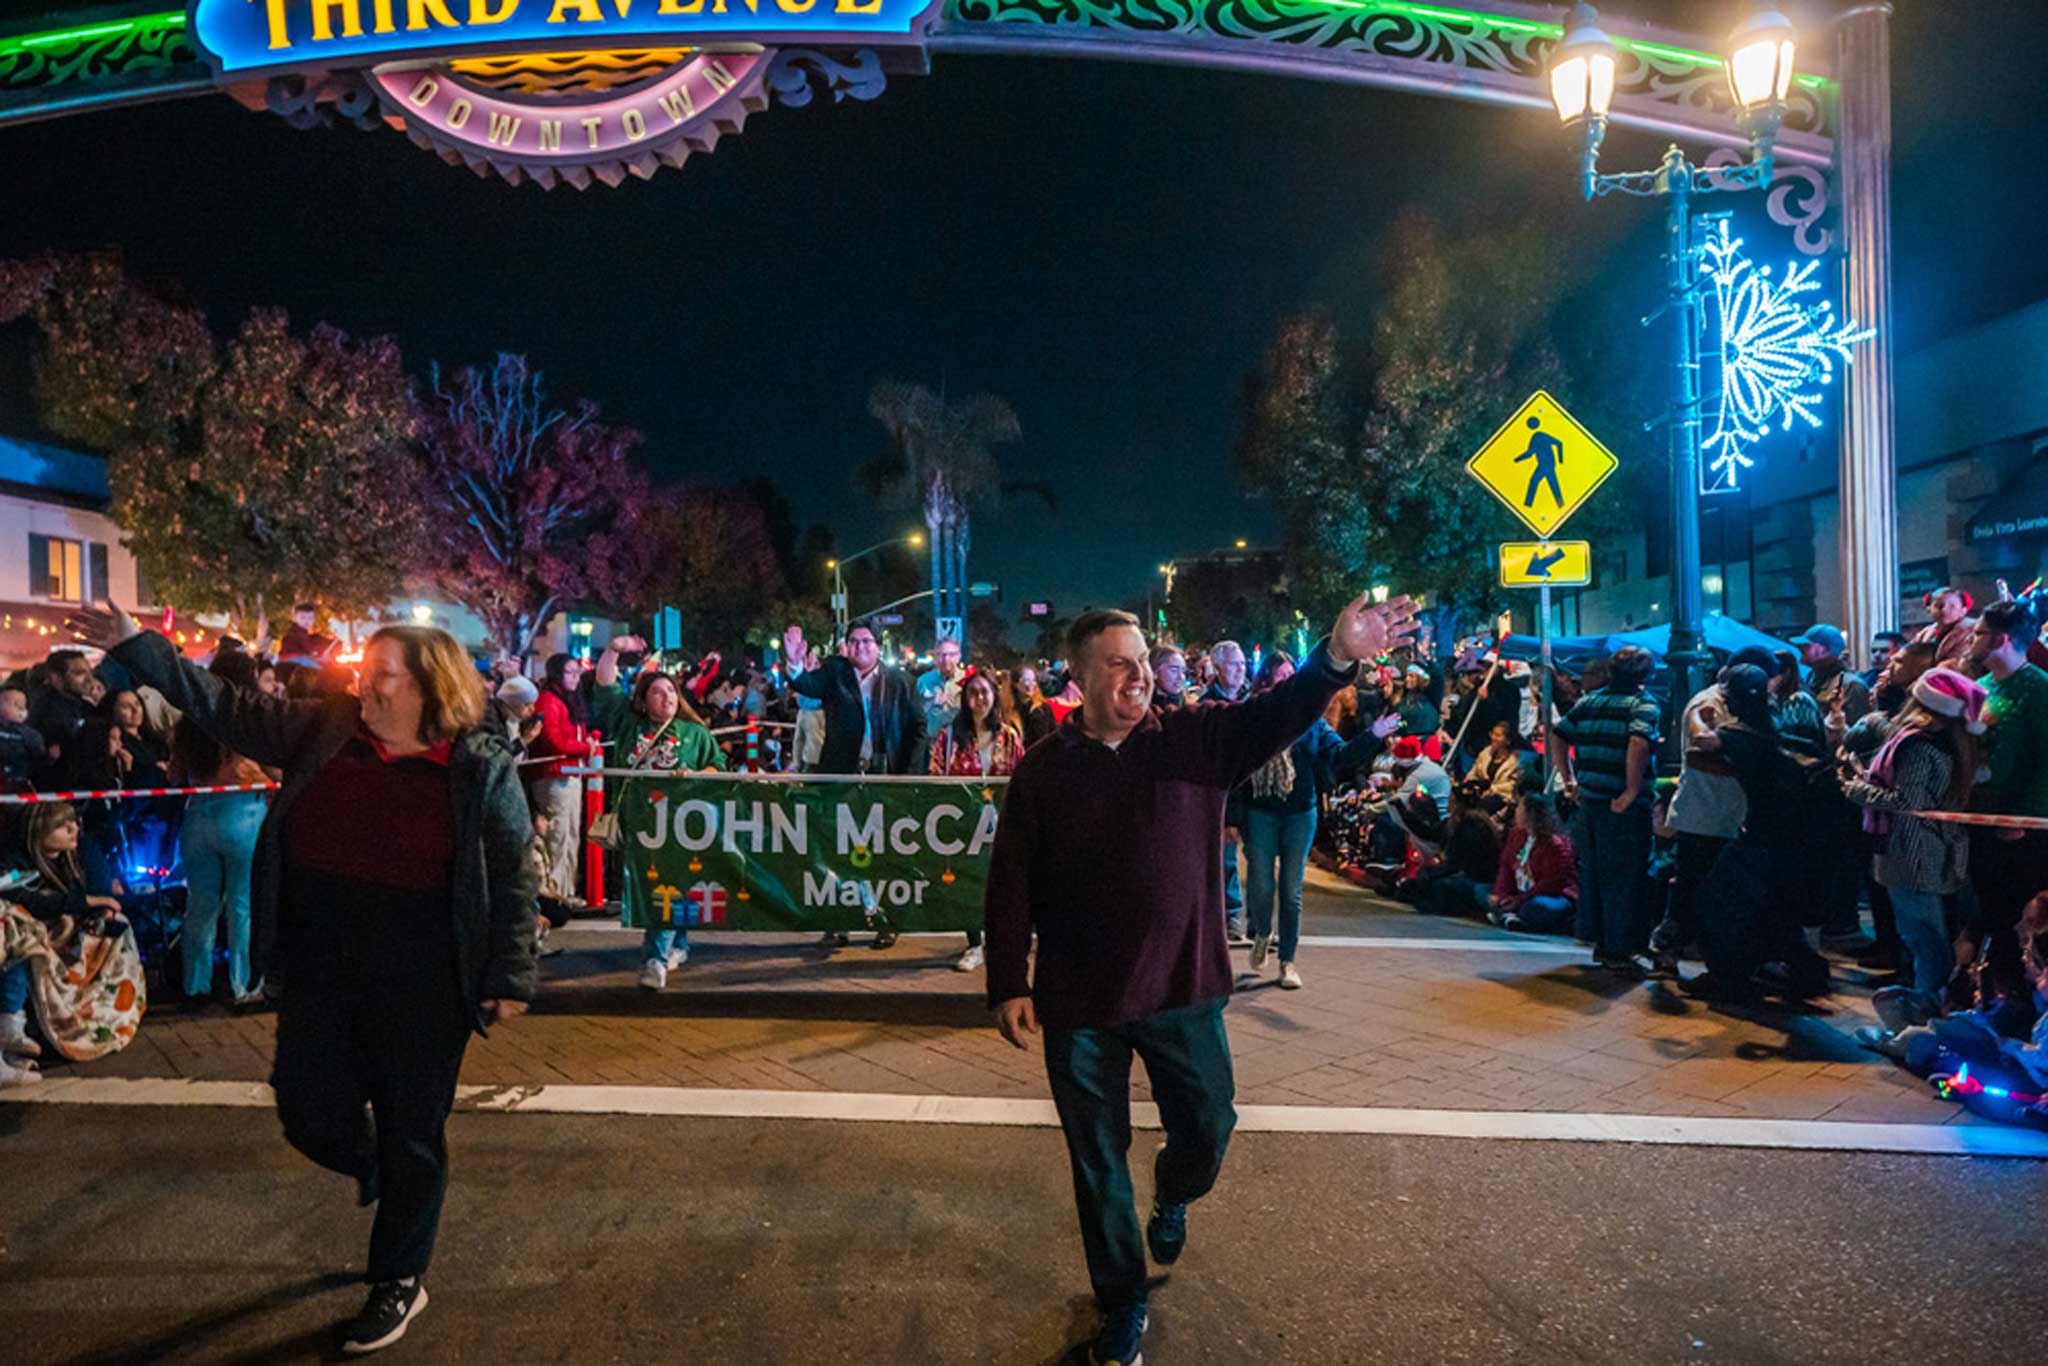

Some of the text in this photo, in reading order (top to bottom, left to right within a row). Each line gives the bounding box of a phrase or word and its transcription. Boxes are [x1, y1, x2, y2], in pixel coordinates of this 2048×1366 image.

[408, 60, 737, 151] DOWNTOWN
[637, 798, 808, 855] JOHN
[803, 871, 931, 916] Mayor
